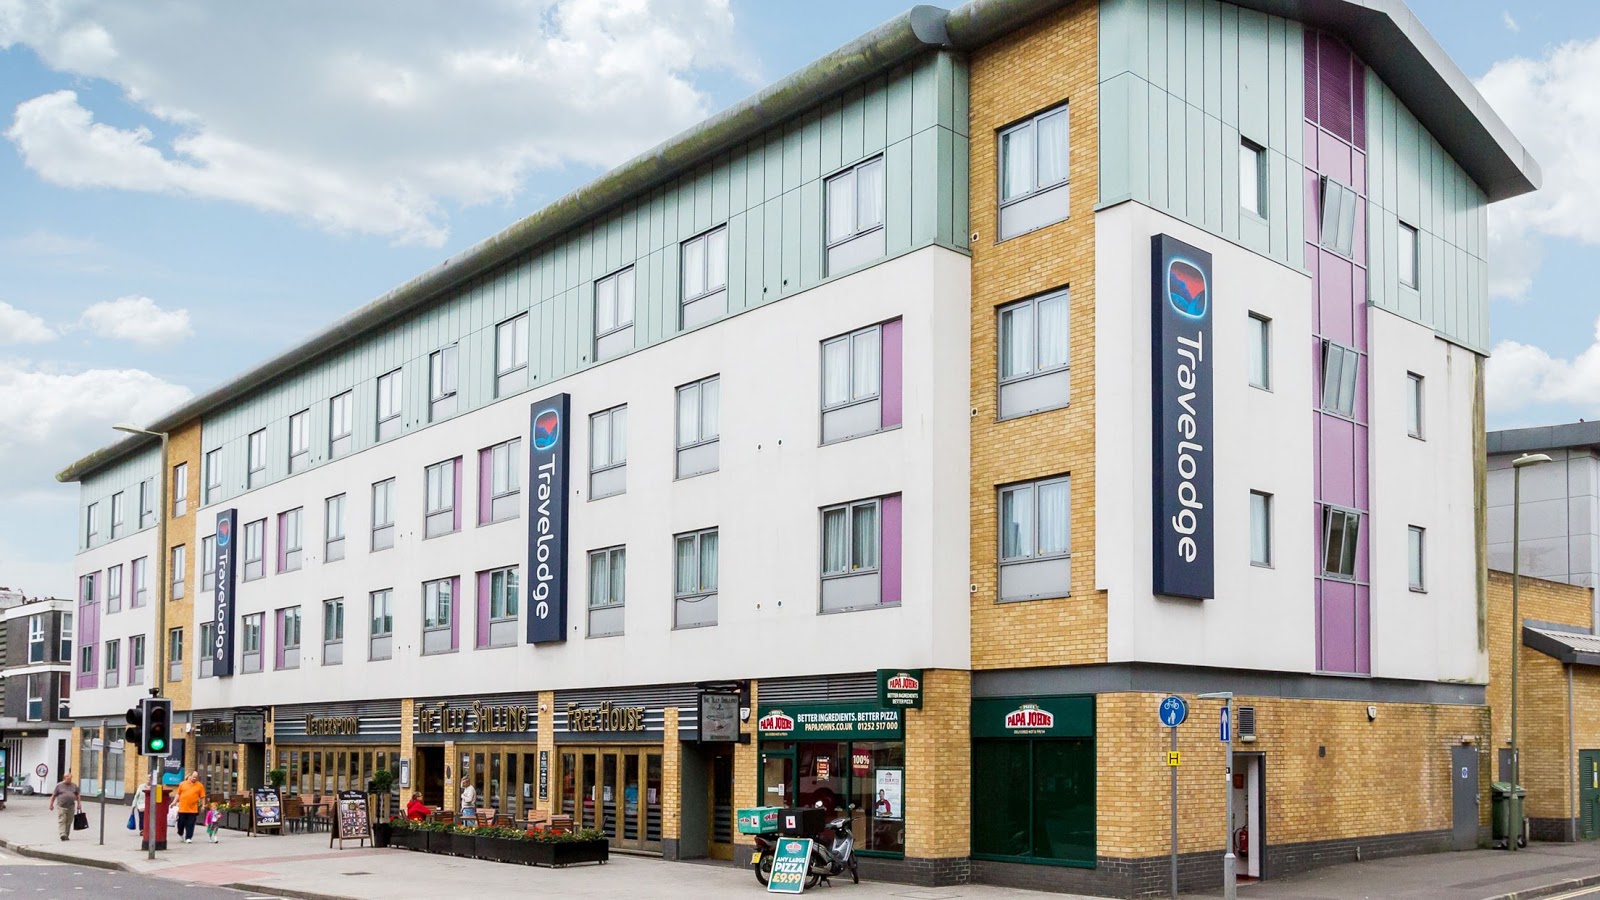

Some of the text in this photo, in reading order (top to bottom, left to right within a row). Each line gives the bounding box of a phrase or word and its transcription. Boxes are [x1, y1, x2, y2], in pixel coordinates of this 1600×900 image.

[1172, 331, 1203, 563] Travelodge
[533, 453, 555, 620] Travelodge
[215, 549, 228, 661] Travelodge
[306, 712, 359, 735] WETHERSPOON
[414, 700, 528, 733] THE TILLY SHILLING
[567, 700, 646, 732] FREE HOUSE
[760, 716, 774, 730] PAPA
[797, 711, 898, 723] BETTER INGREDIENTS. BETTER PIZZA
[1007, 711, 1026, 727] PAPA
[804, 721, 898, 731] PAPAJOHNS.CO.UK 01252 517 000
[852, 754, 870, 765] 100%
[1169, 752, 1178, 765] H
[774, 862, 803, 873] PIZZA
[772, 872, 801, 884] £9.99
